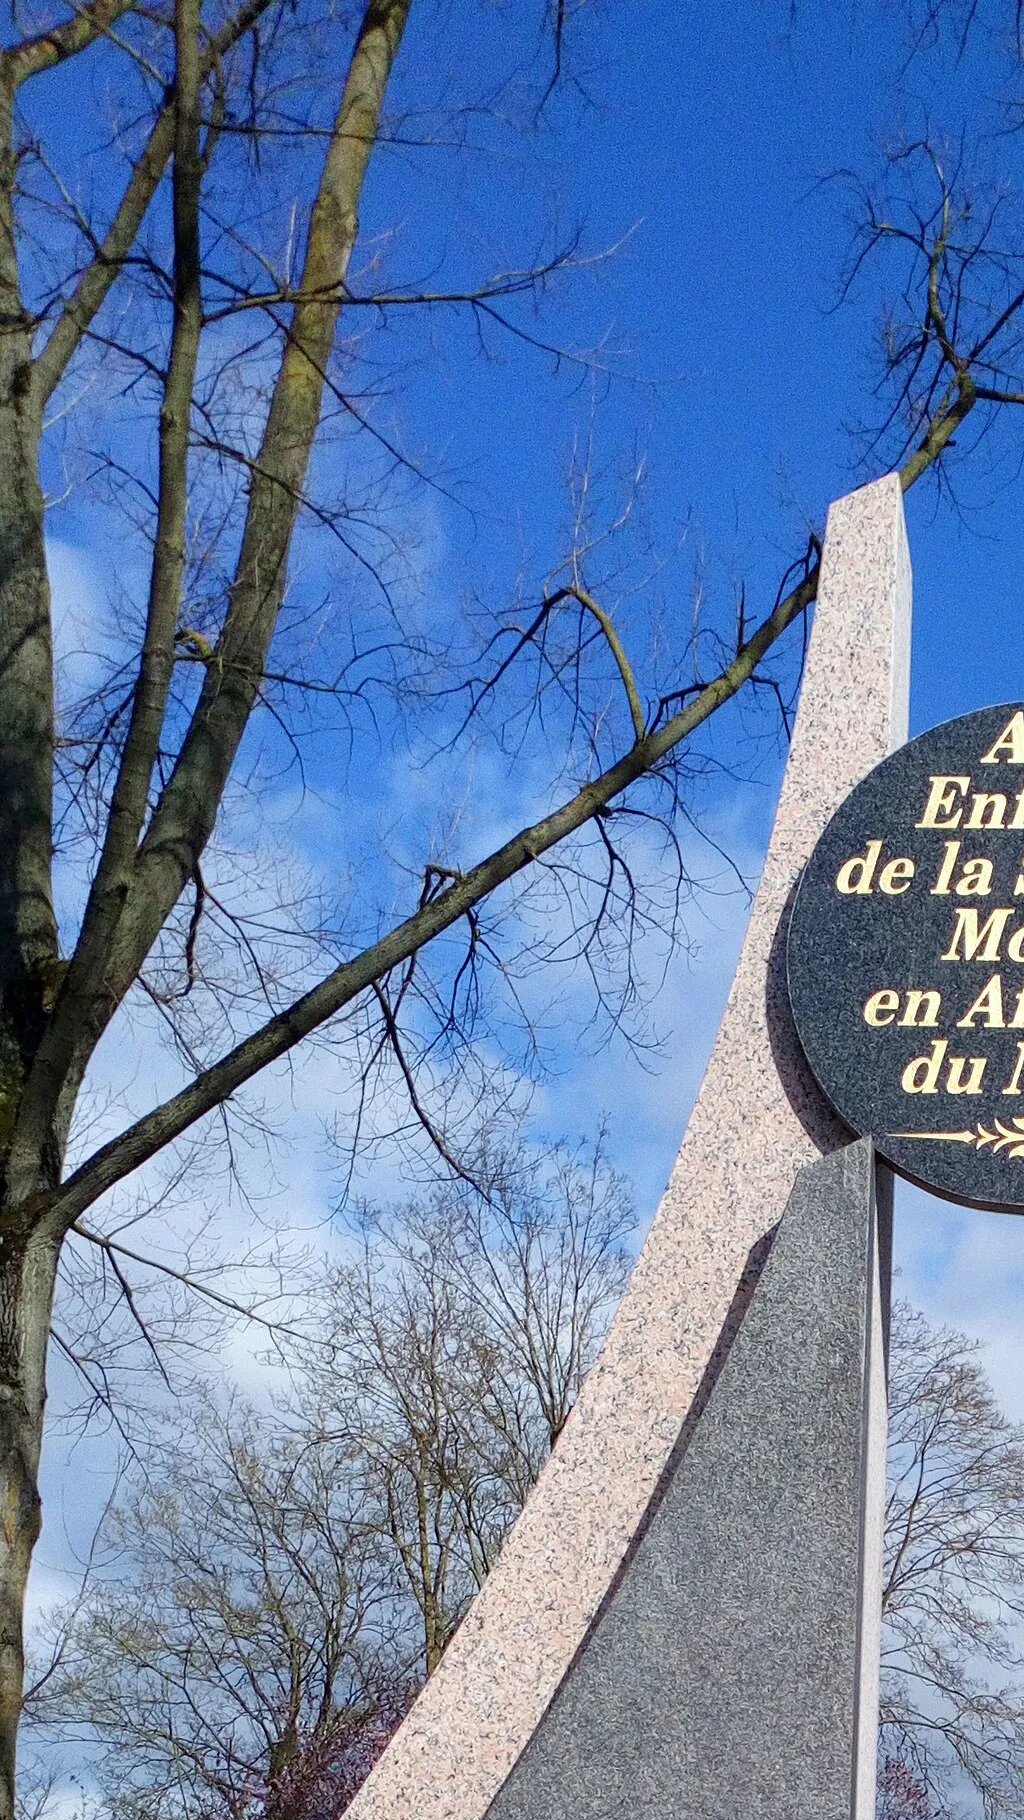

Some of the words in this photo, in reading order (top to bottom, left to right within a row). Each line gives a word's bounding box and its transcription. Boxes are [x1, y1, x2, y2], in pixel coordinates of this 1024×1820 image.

[836, 840, 914, 895] de
[930, 840, 994, 895] la
[864, 989, 941, 1027] en
[901, 1039, 987, 1094] du
